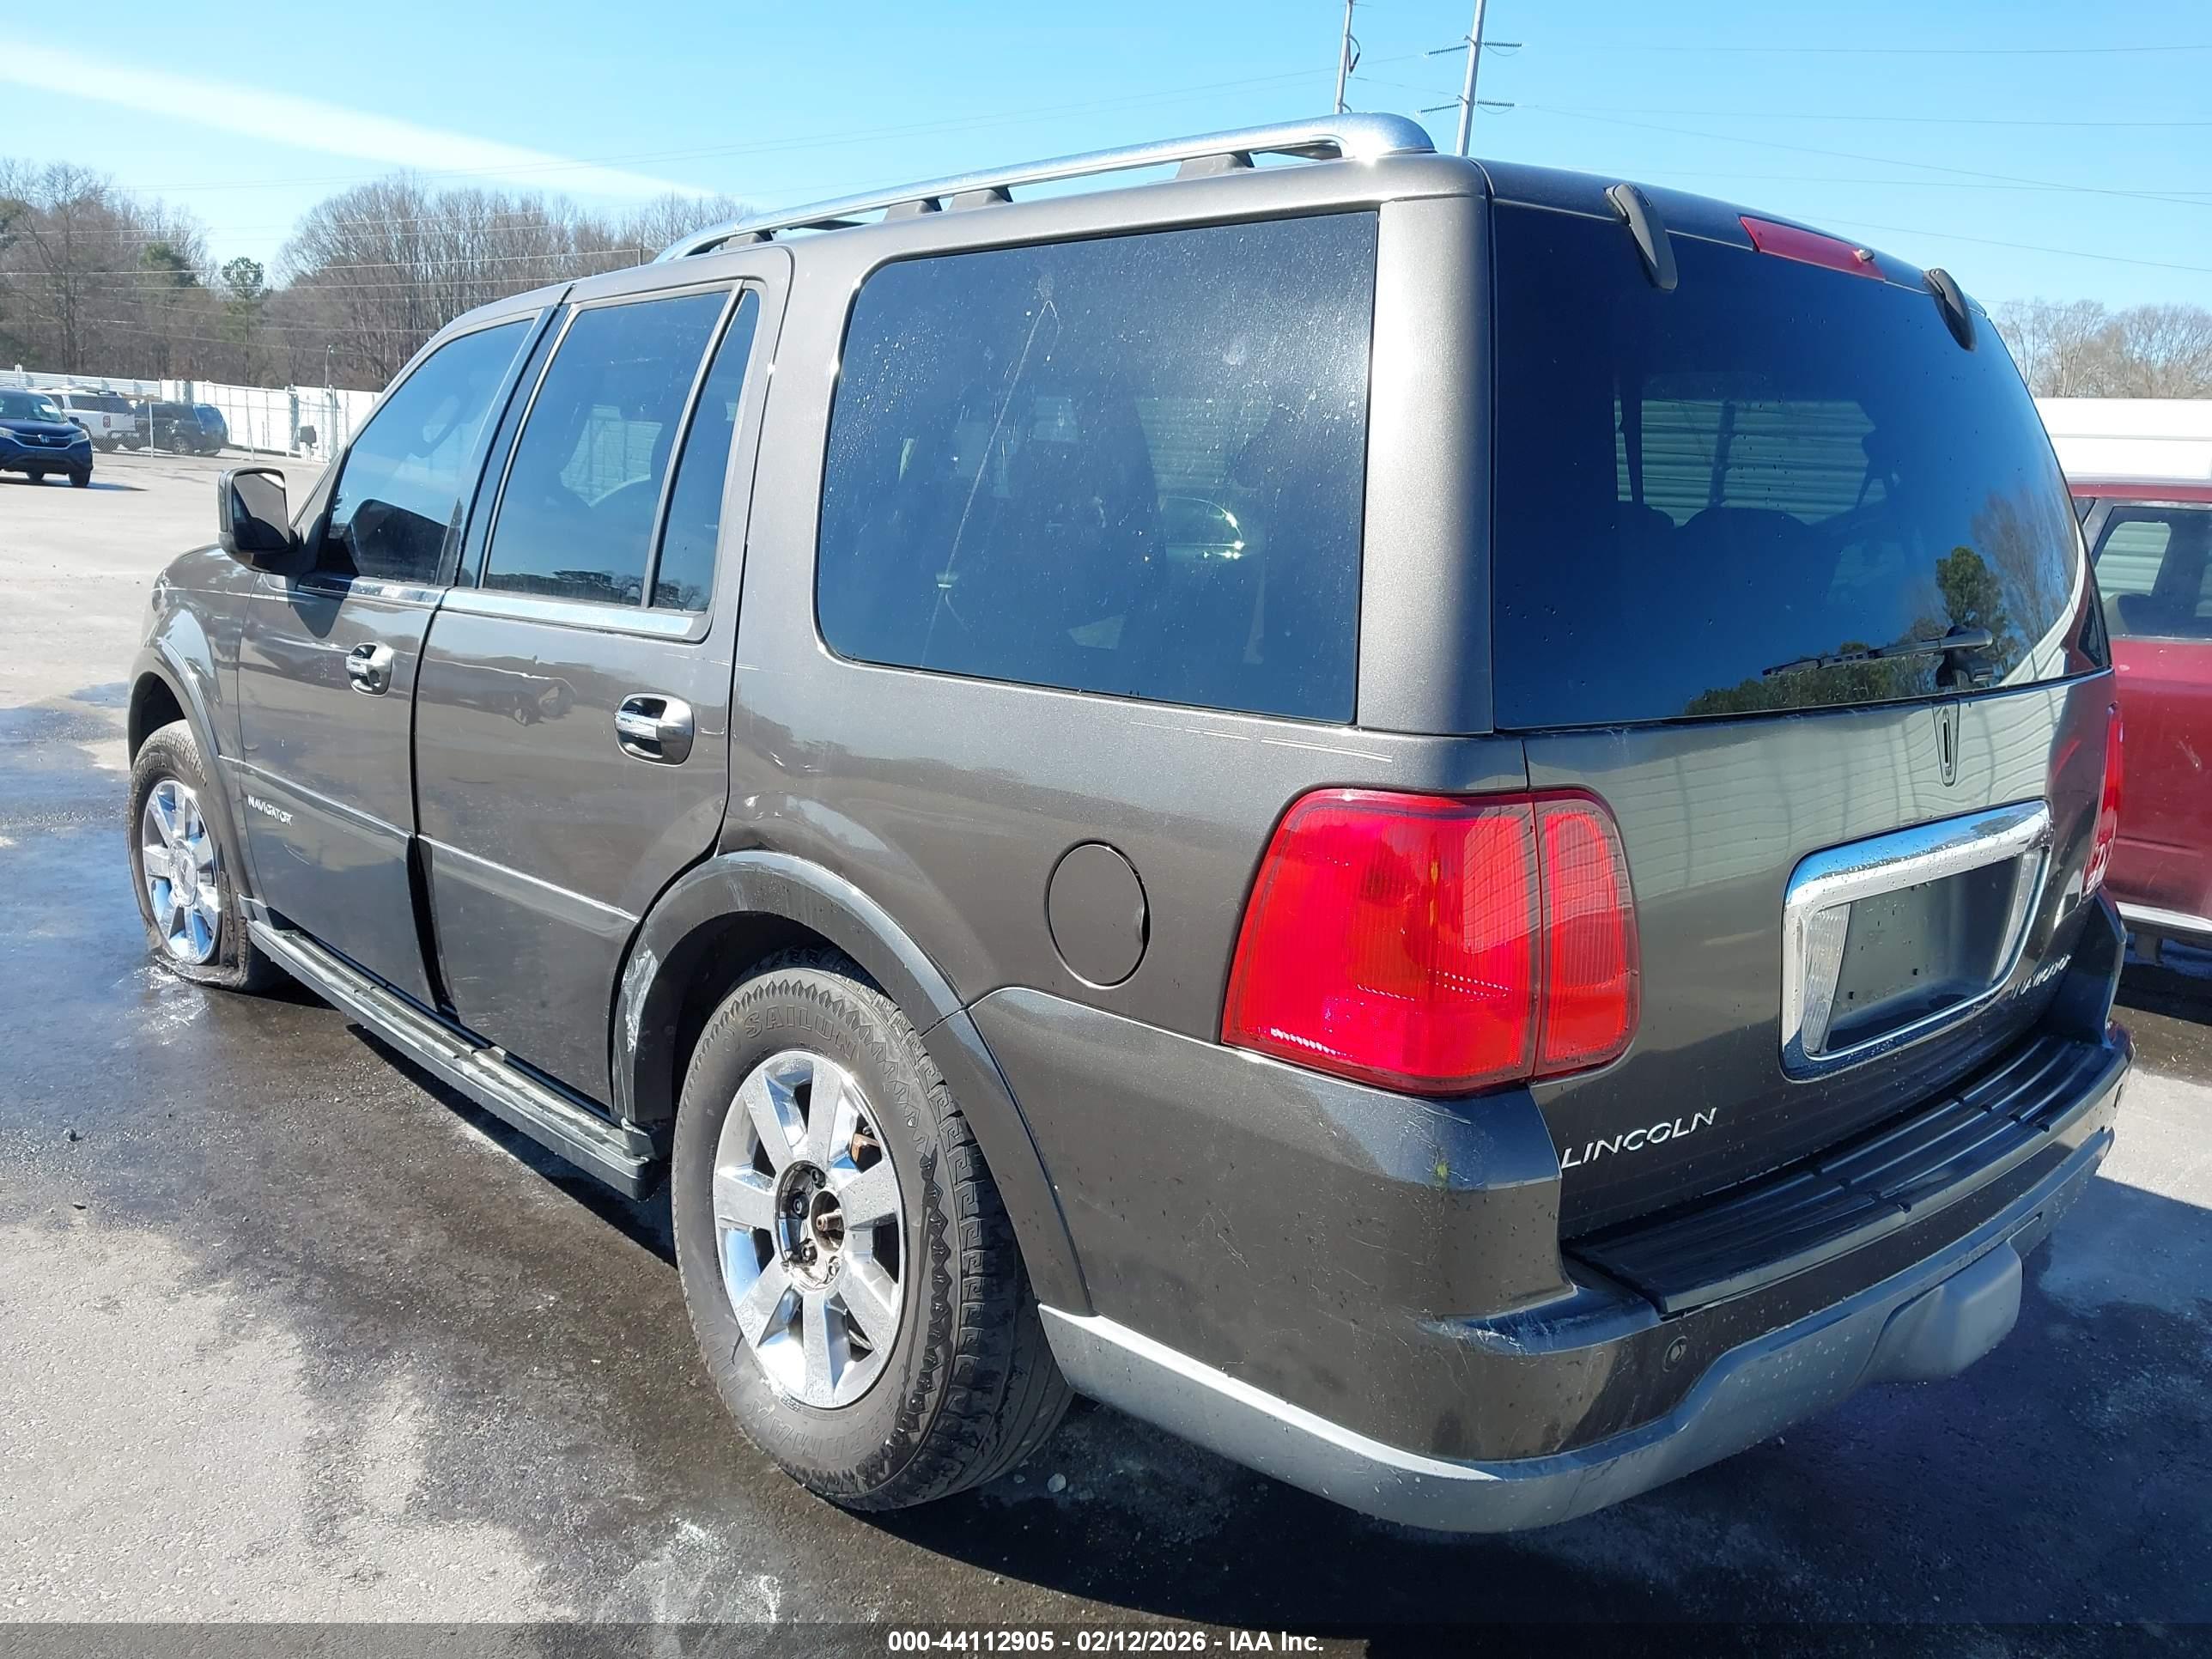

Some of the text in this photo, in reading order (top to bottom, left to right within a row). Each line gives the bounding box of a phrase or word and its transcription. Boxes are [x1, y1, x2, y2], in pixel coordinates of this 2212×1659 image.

[247, 793, 294, 826] NAVIGATOR
[744, 1006, 858, 1060] SAILUN
[1560, 1106, 1717, 1170] LINCOLN
